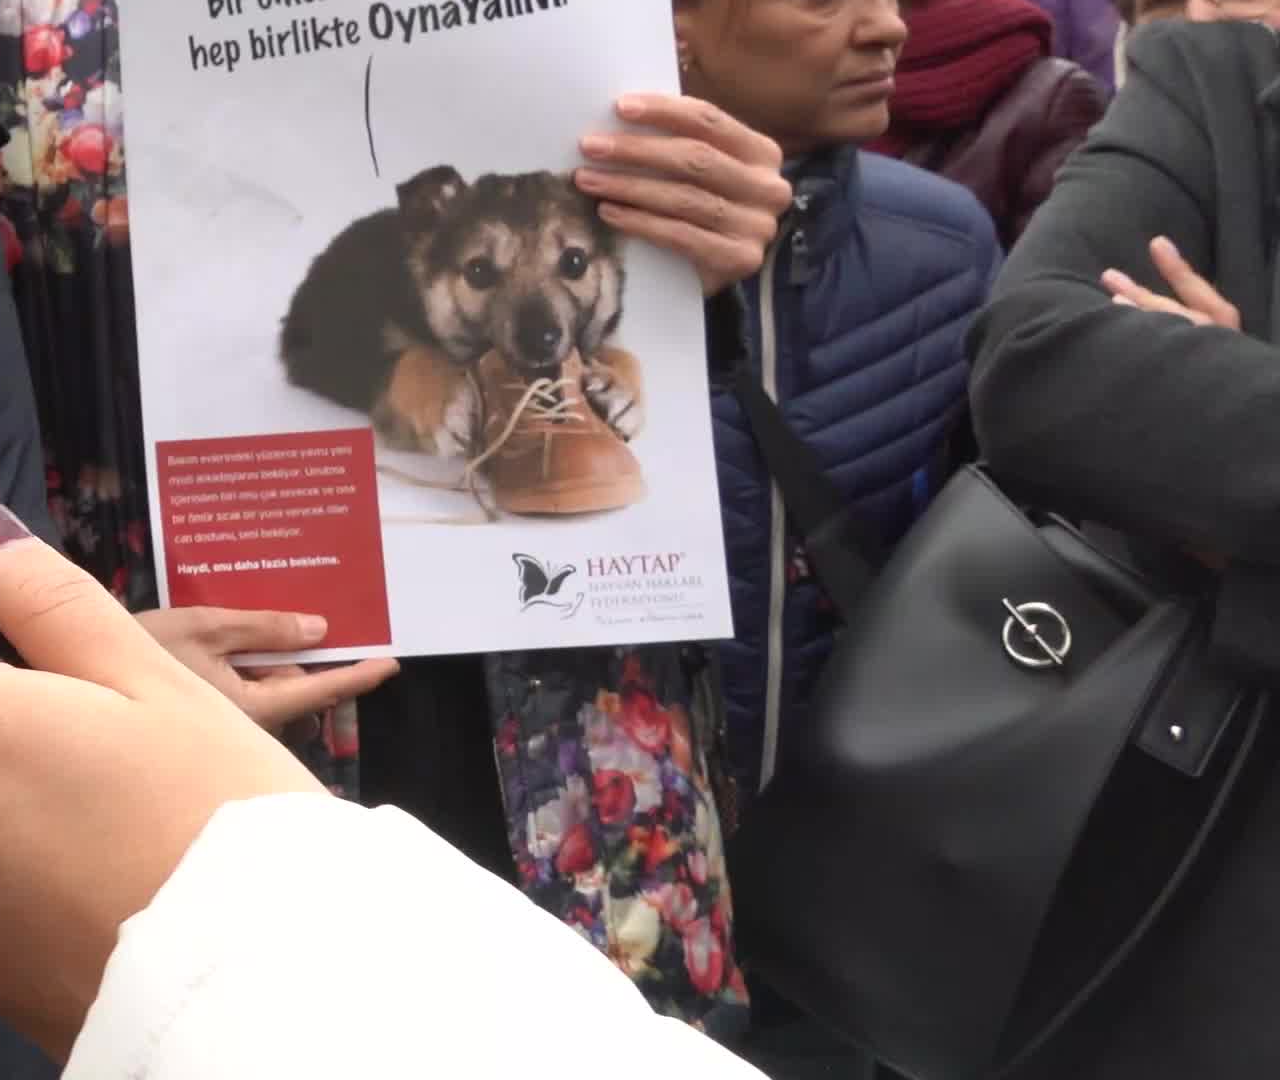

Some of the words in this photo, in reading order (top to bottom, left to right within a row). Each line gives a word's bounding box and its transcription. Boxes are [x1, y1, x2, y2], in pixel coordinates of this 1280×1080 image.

[188, 34, 241, 71] hep
[249, 17, 361, 59] birlikte
[234, 559, 259, 570] daha
[587, 552, 680, 577] HAYTAP
